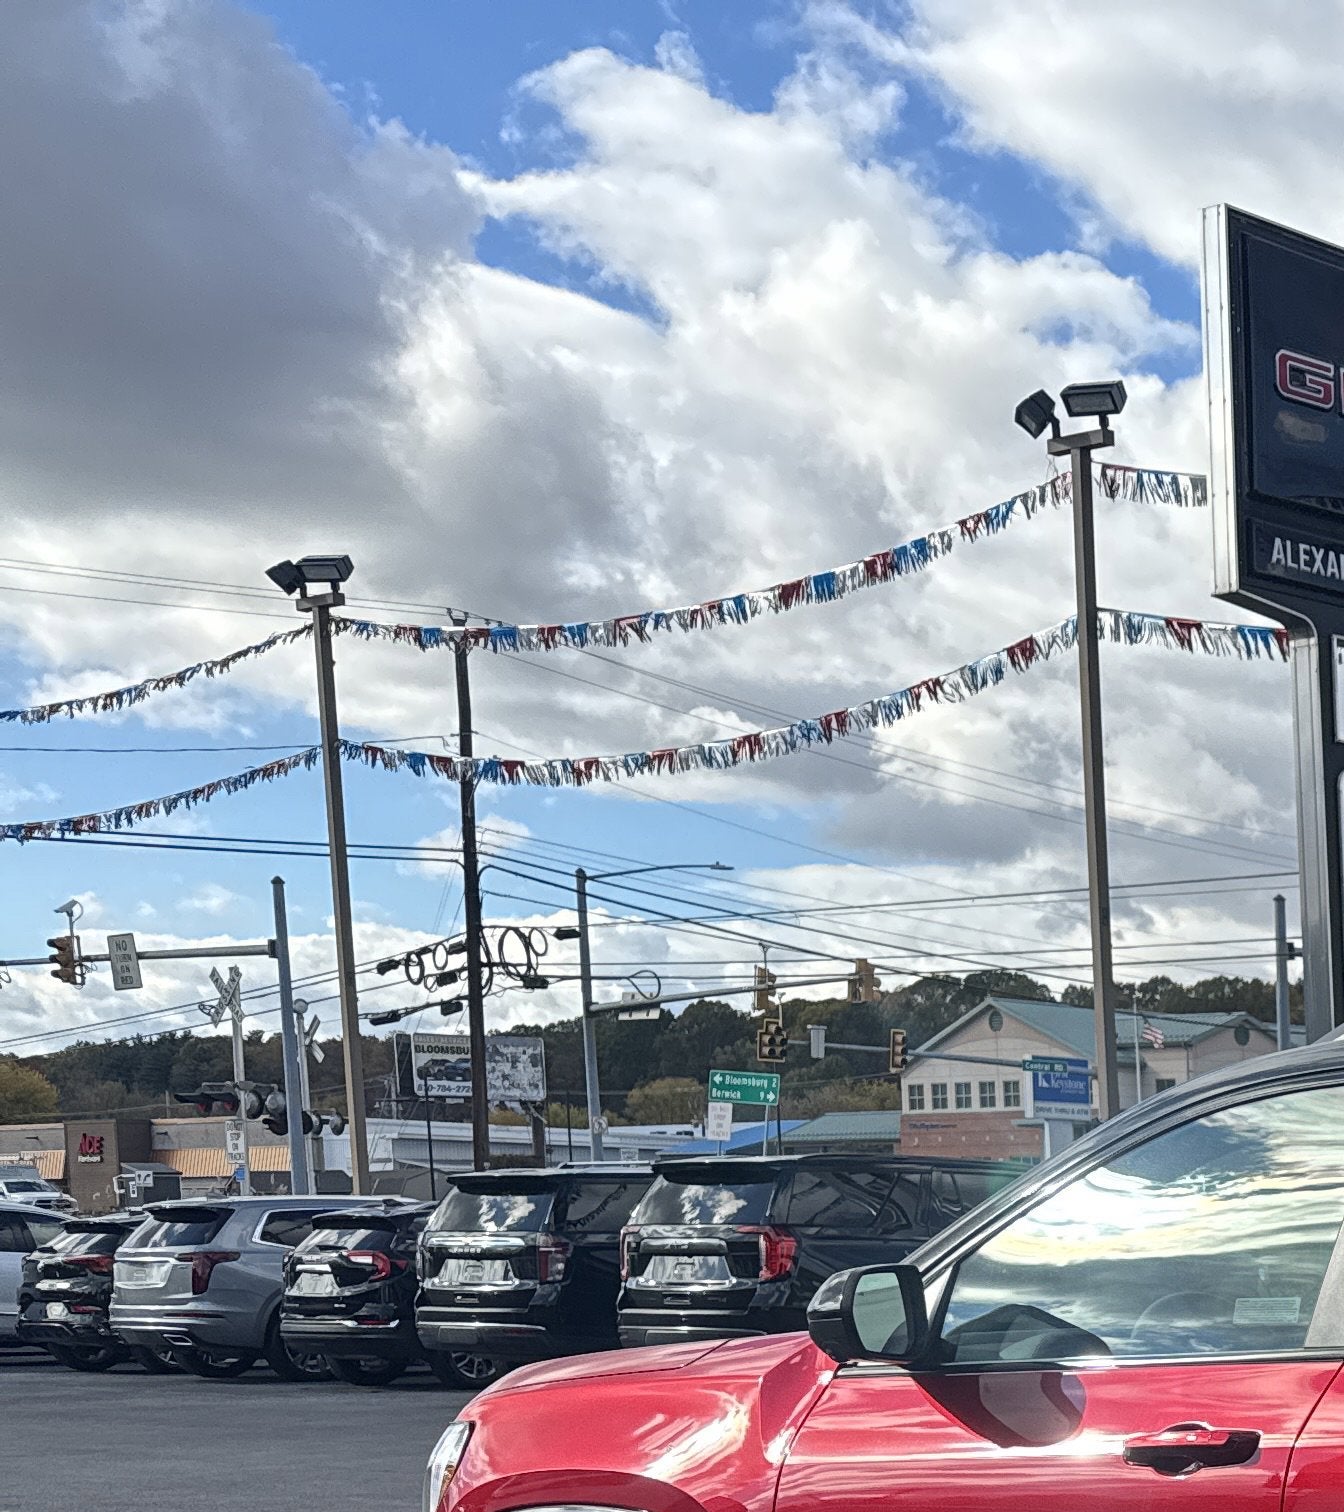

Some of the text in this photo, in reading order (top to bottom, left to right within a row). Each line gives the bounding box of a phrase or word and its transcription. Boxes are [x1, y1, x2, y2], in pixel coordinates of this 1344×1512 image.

[115, 940, 127, 951] NO
[415, 1044, 470, 1055] BLOOMSBU
[1025, 1062, 1051, 1071] Central
[725, 1074, 777, 1089] Bloomsburg 2
[711, 1088, 765, 1100] Berwick 9
